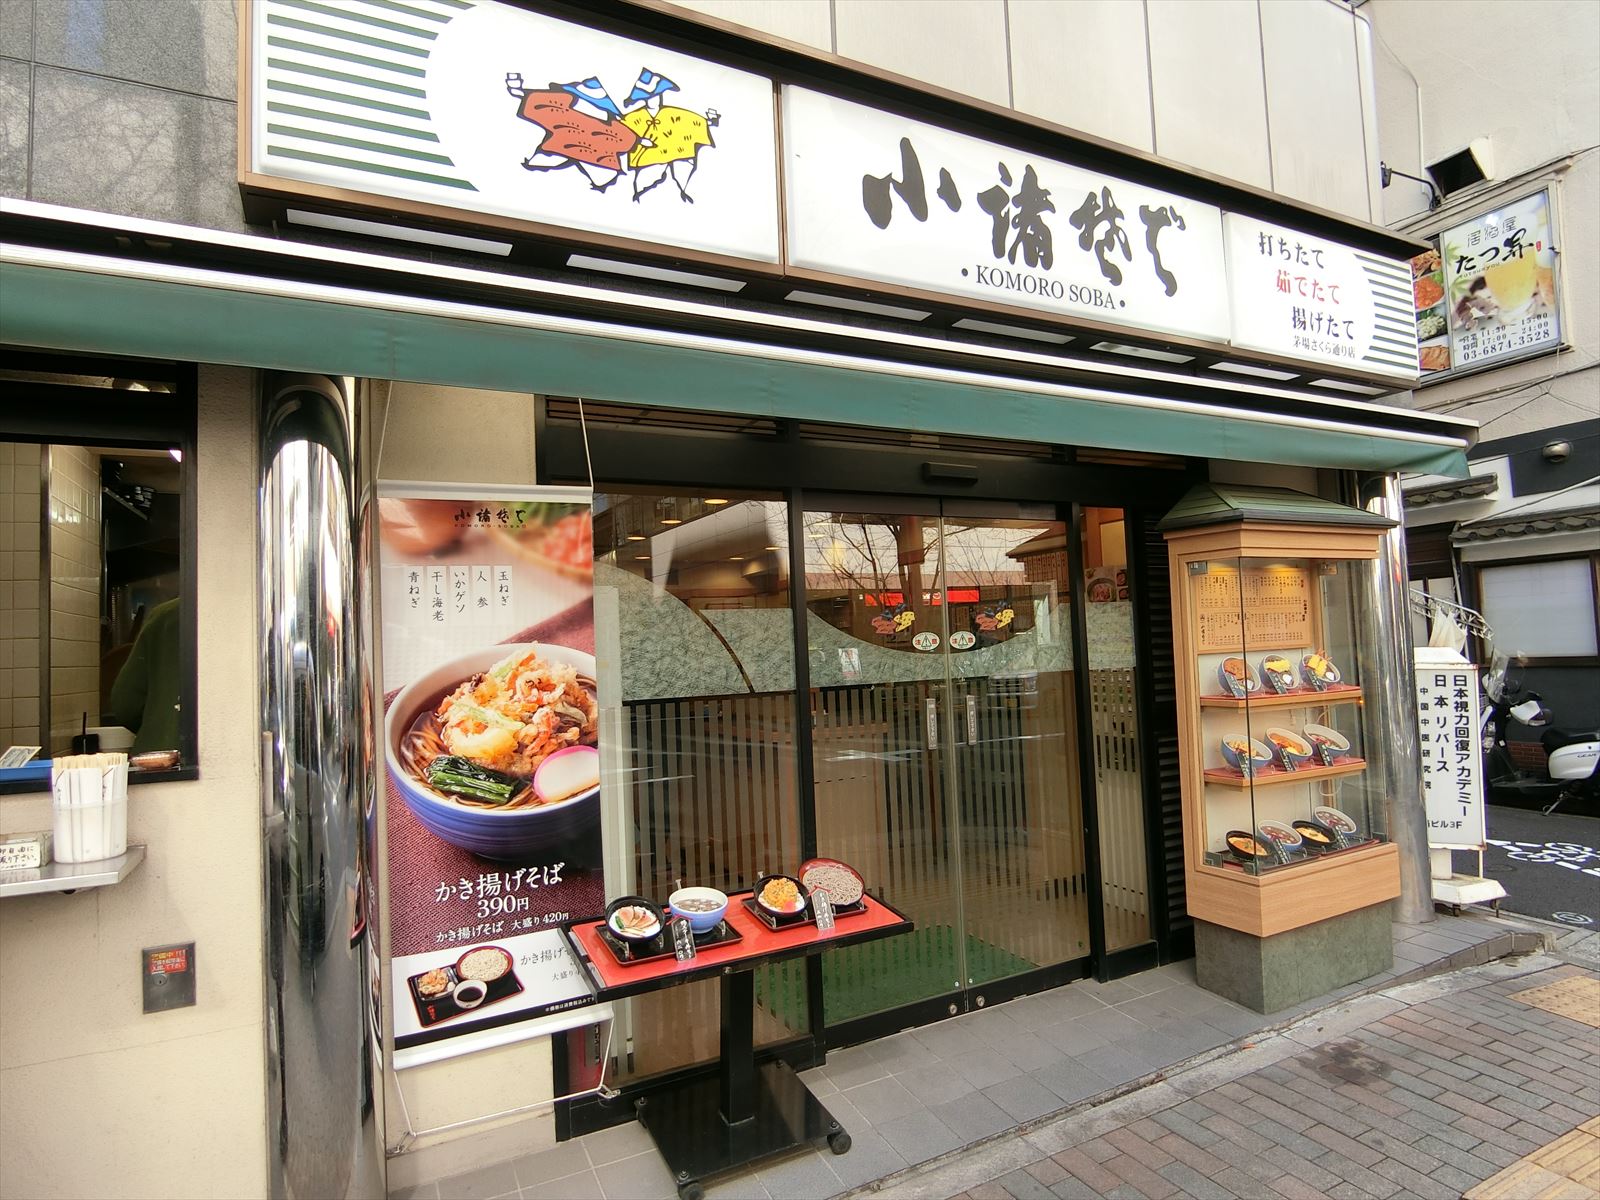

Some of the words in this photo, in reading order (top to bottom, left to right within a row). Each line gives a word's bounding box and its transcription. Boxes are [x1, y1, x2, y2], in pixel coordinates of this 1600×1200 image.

[1258, 231, 1324, 269] 打ちたて
[976, 265, 1064, 299] KOMORO
[1068, 284, 1117, 310] SOBA
[1276, 269, 1340, 305] 茹でたて
[1292, 306, 1354, 340] 揚げたて
[1463, 329, 1550, 361] 03-6874-3528
[408, 571, 421, 609] 青ねぎ
[431, 571, 445, 622] 干し海老
[454, 571, 466, 613] いかゲソ
[476, 571, 489, 608] 人参
[498, 571, 509, 606] 玉ねぎ
[1433, 674, 1450, 773] 日本リバース
[1453, 674, 1472, 817] 日本視力回復アカデミー
[434, 862, 566, 902] かき揚げそば
[477, 894, 530, 919] 390円
[436, 920, 505, 943] かき揚げそば
